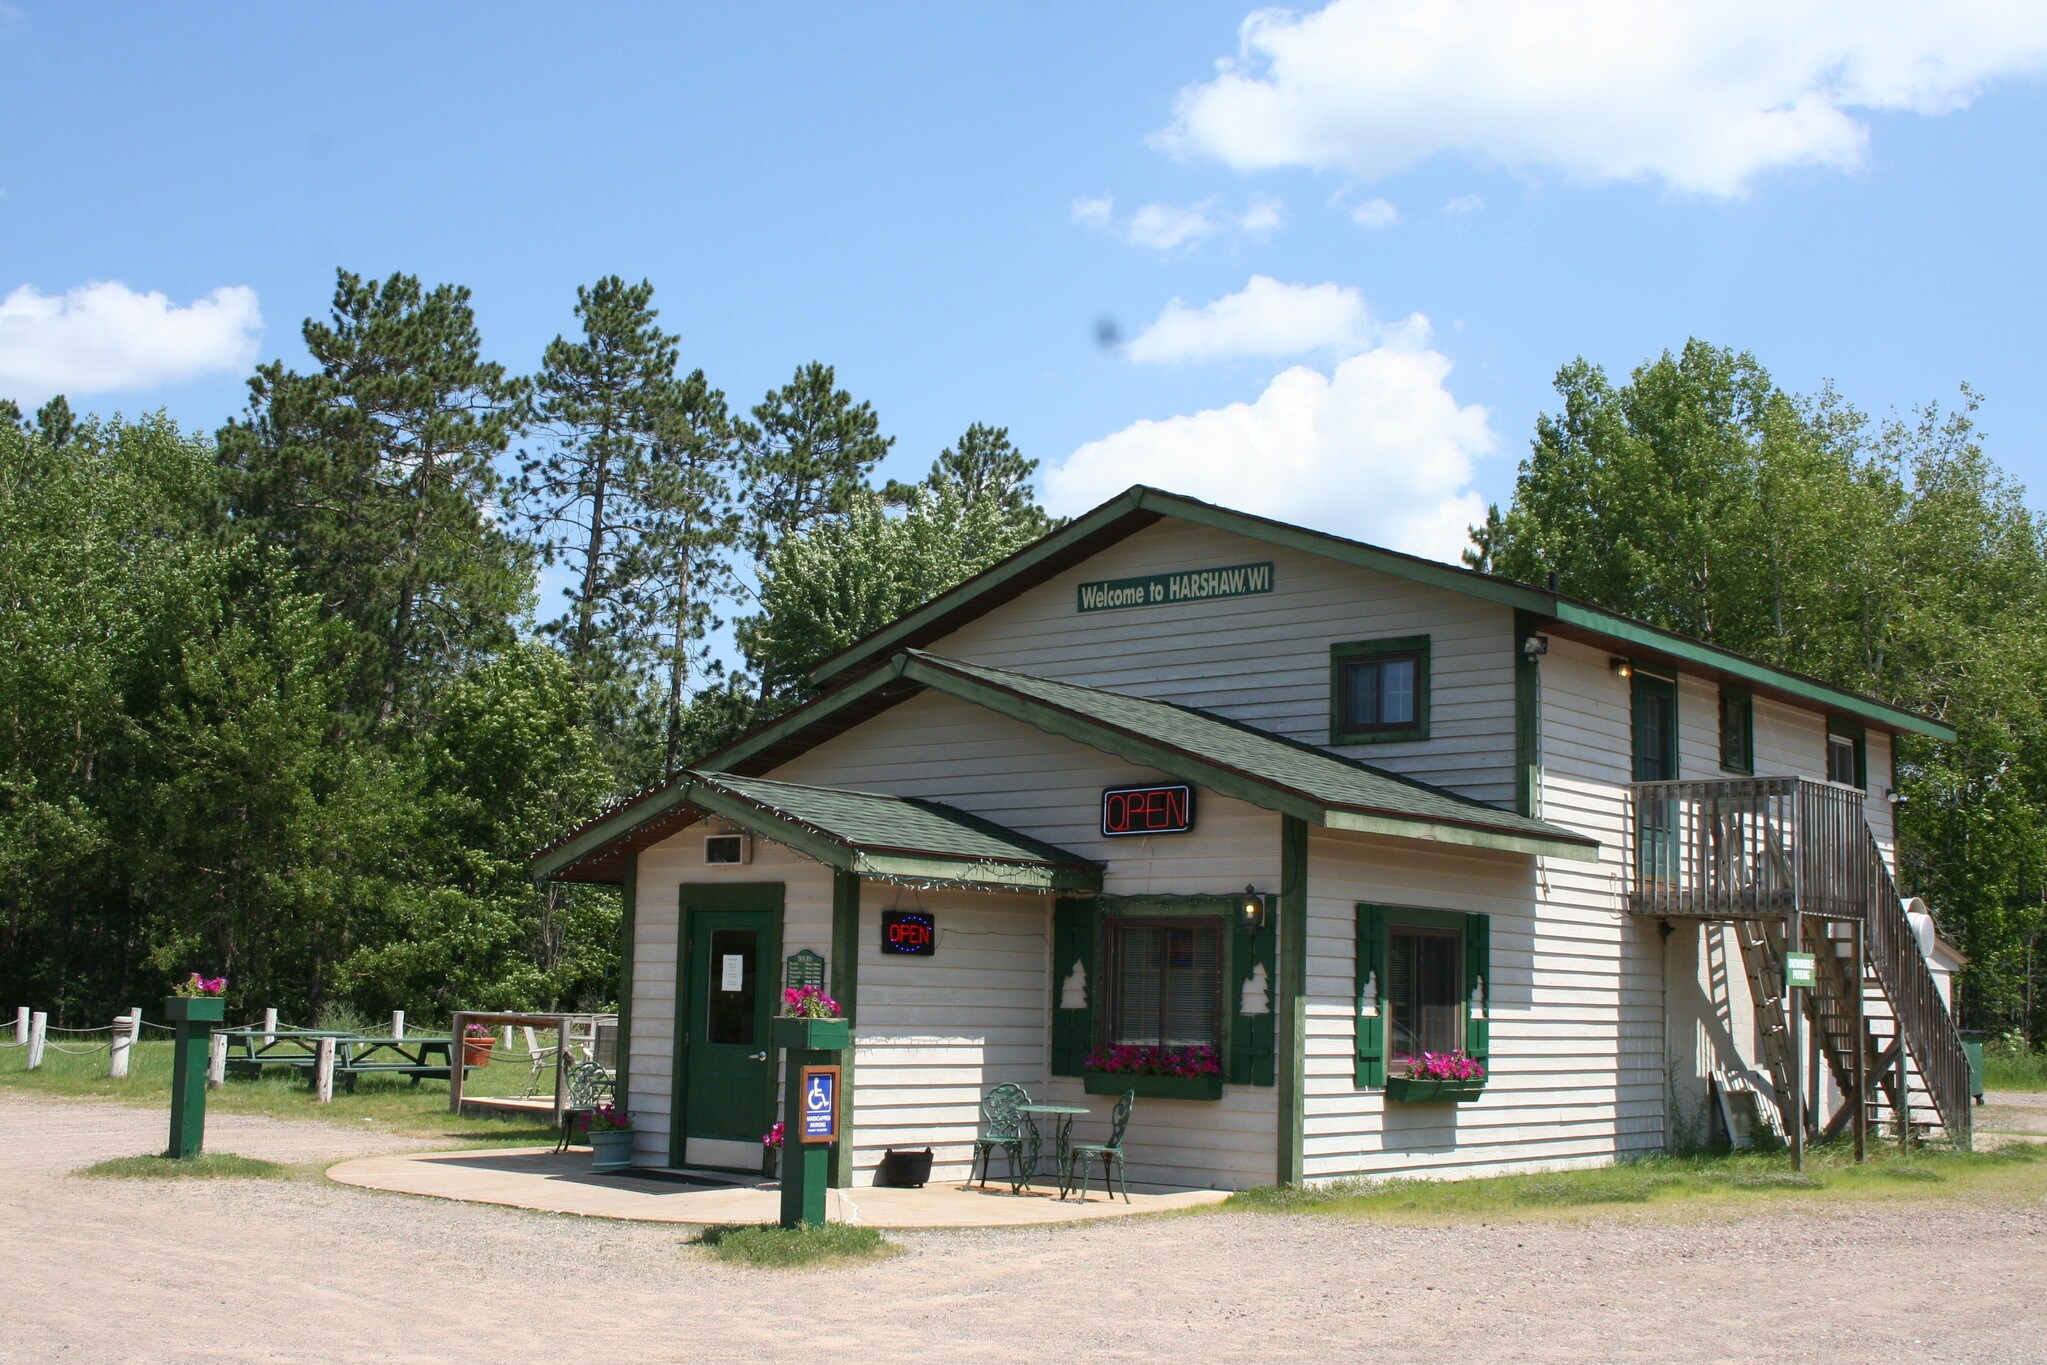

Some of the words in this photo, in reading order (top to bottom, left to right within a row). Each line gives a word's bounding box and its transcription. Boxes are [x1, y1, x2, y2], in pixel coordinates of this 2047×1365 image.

[1081, 583, 1144, 609] Welcome
[1150, 582, 1164, 602] to
[1247, 566, 1269, 591] WI
[1107, 791, 1186, 831] OPEN
[889, 923, 930, 944] OPEN
[1788, 958, 1815, 969] SNOWMOBILE
[1792, 969, 1810, 980] PARKING
